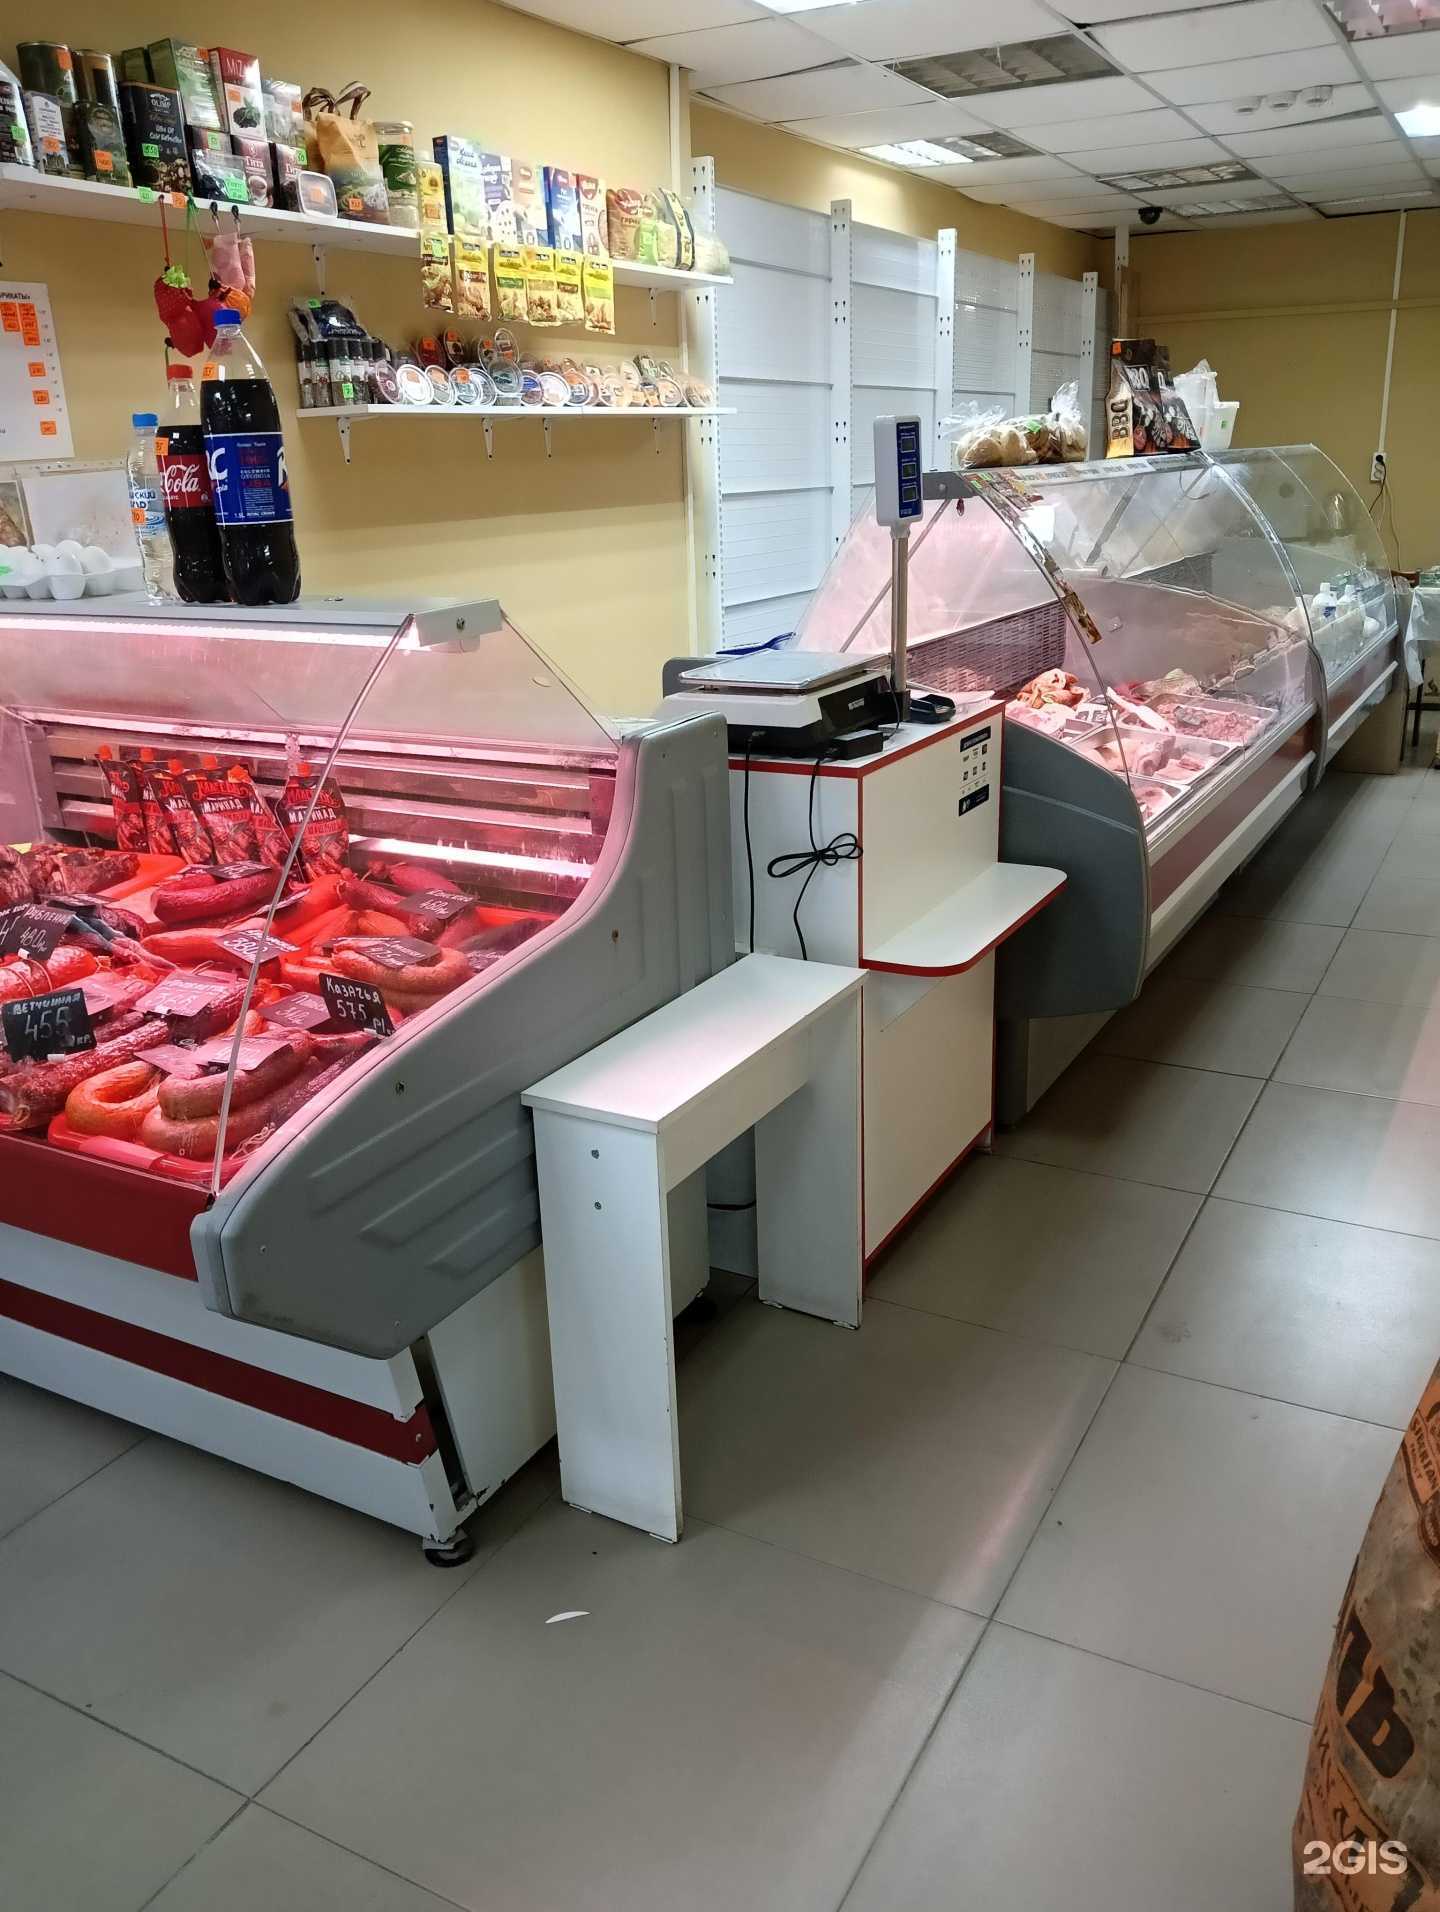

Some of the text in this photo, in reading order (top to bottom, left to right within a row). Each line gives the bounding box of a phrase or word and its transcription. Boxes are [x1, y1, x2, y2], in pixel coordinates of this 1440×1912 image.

[1110, 402, 1128, 439] BBQ
[202, 798, 244, 814] МАРИНАД
[288, 807, 337, 824] МАИНАД
[336, 999, 367, 1020] 575
[24, 1005, 71, 1041] 455
